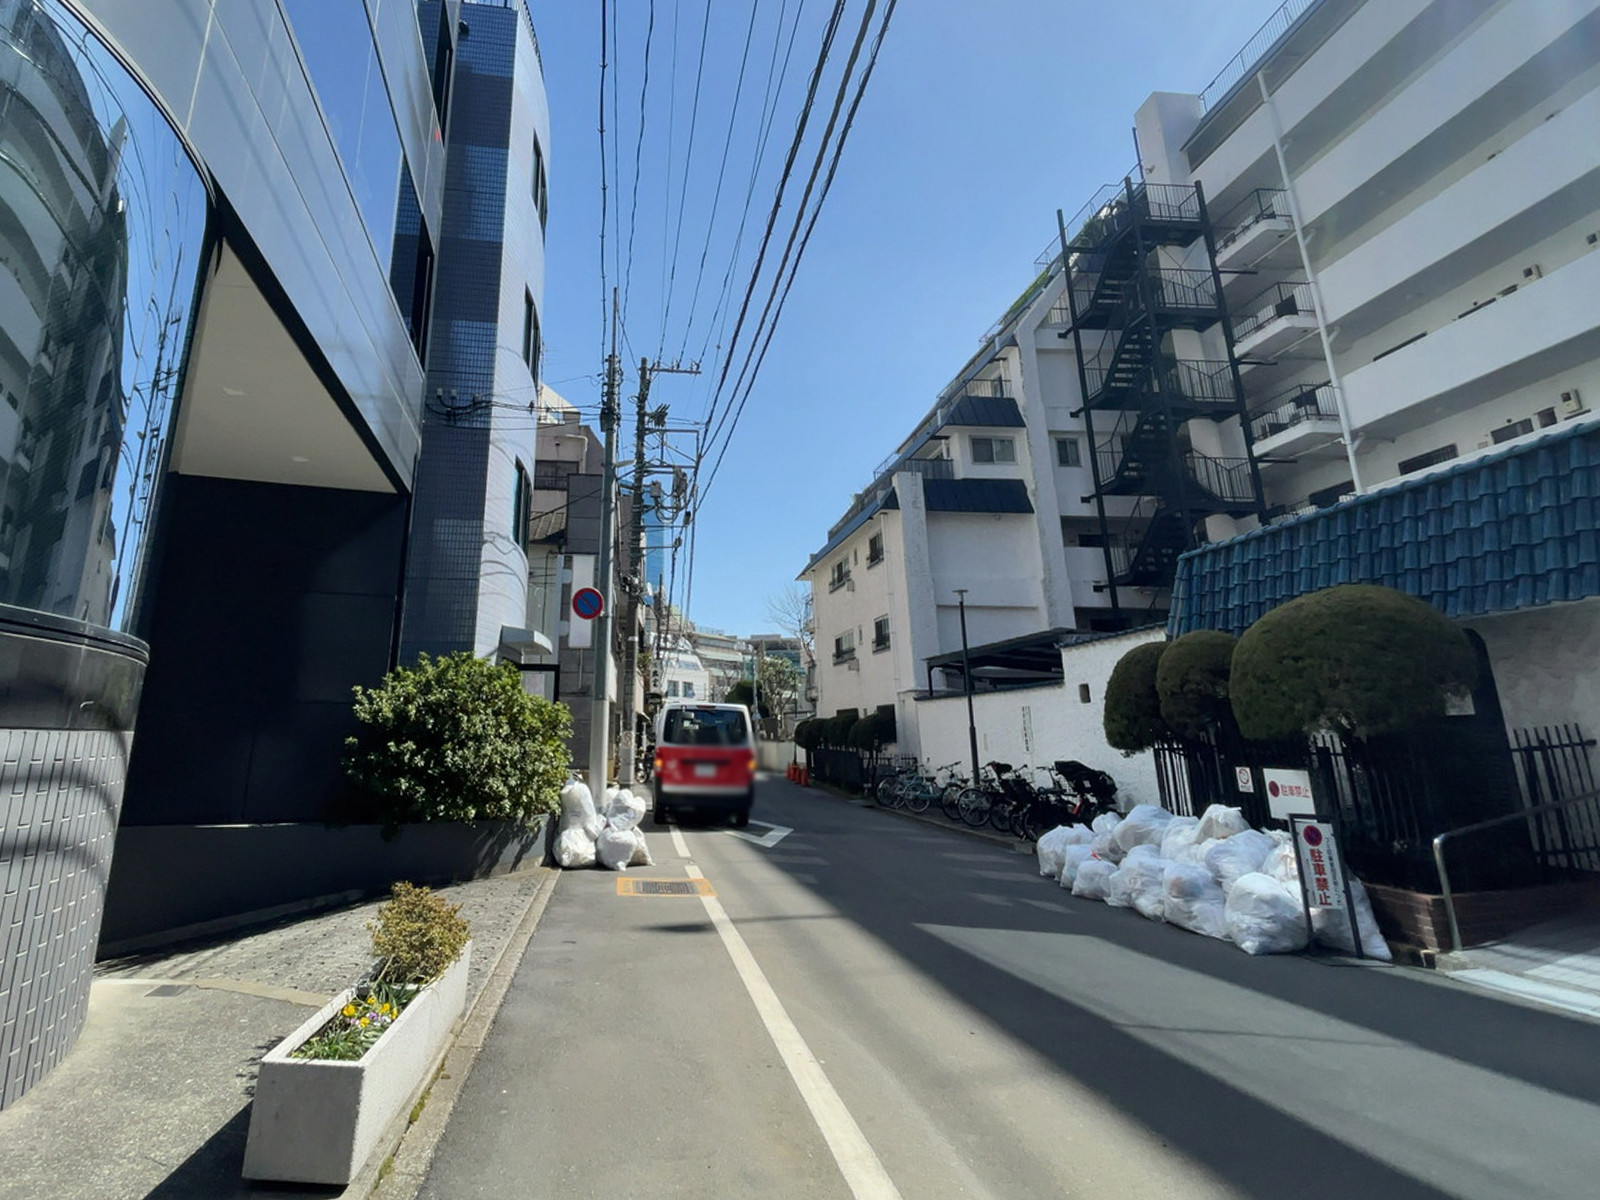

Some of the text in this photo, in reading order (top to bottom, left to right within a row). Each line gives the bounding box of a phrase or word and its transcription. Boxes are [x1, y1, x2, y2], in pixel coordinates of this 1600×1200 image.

[1280, 783, 1310, 798] 駐車禁止
[1309, 848, 1332, 906] 駐車禁止
